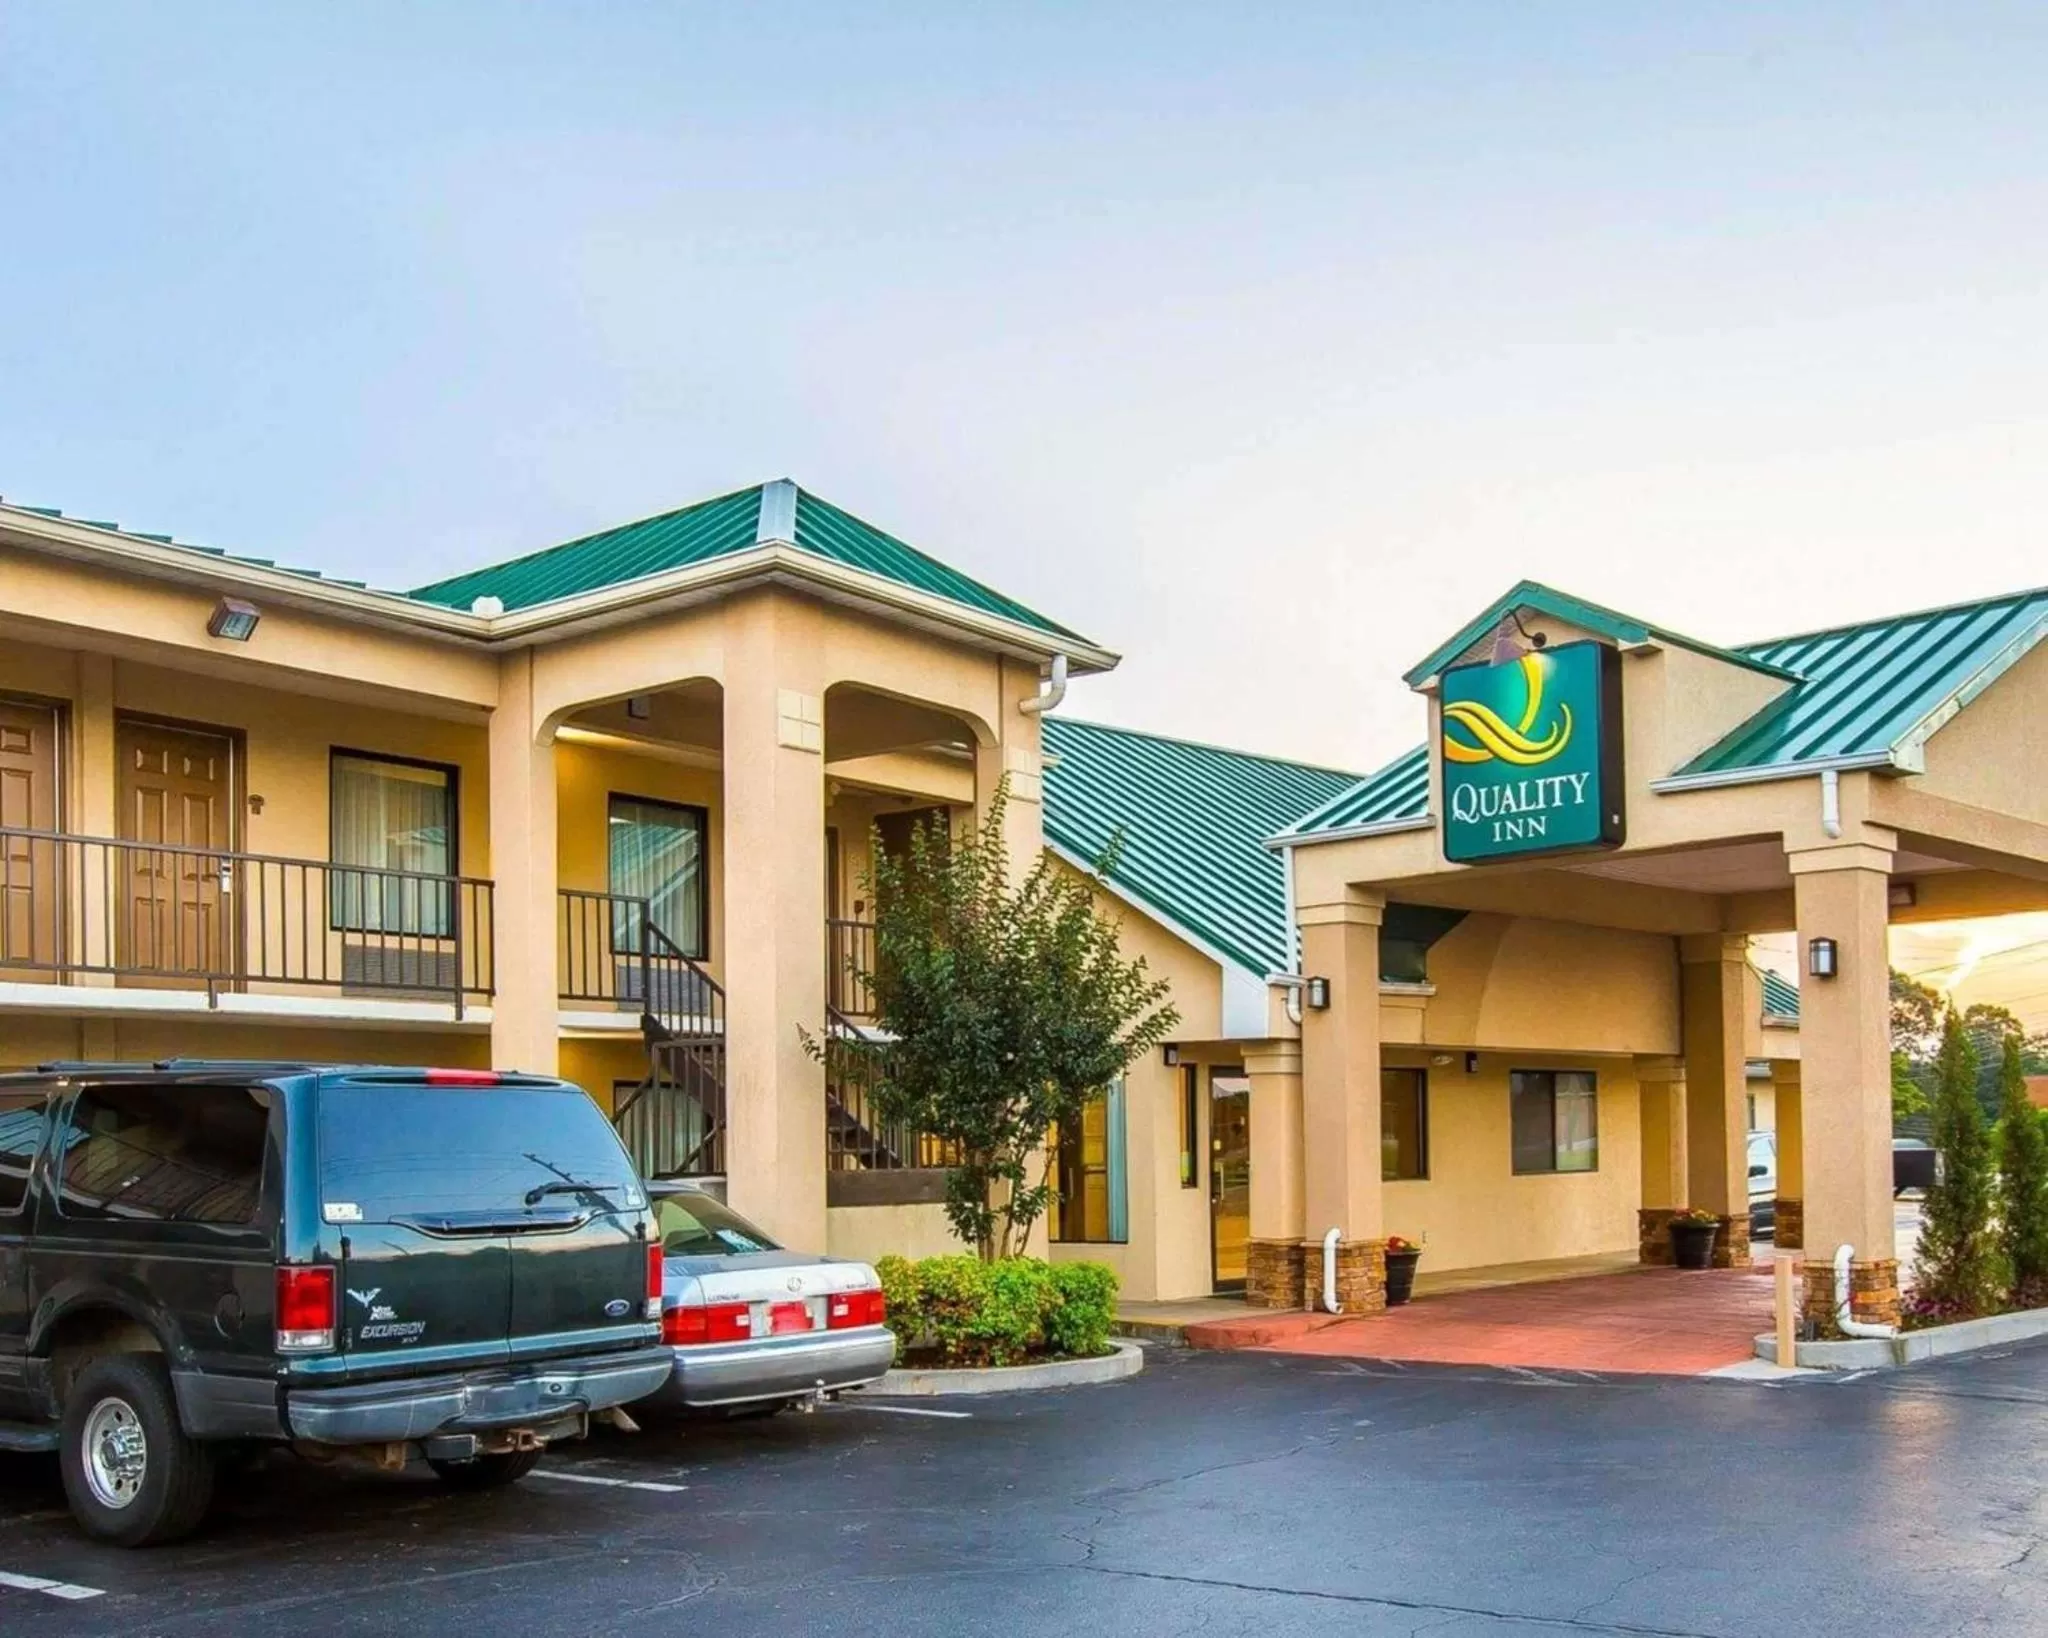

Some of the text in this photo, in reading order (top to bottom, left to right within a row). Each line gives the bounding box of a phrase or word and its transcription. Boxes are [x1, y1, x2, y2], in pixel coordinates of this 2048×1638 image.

[1452, 772, 1590, 824] QUALITY
[1493, 815, 1548, 842] INN
[360, 1321, 426, 1339] EXCURSION
